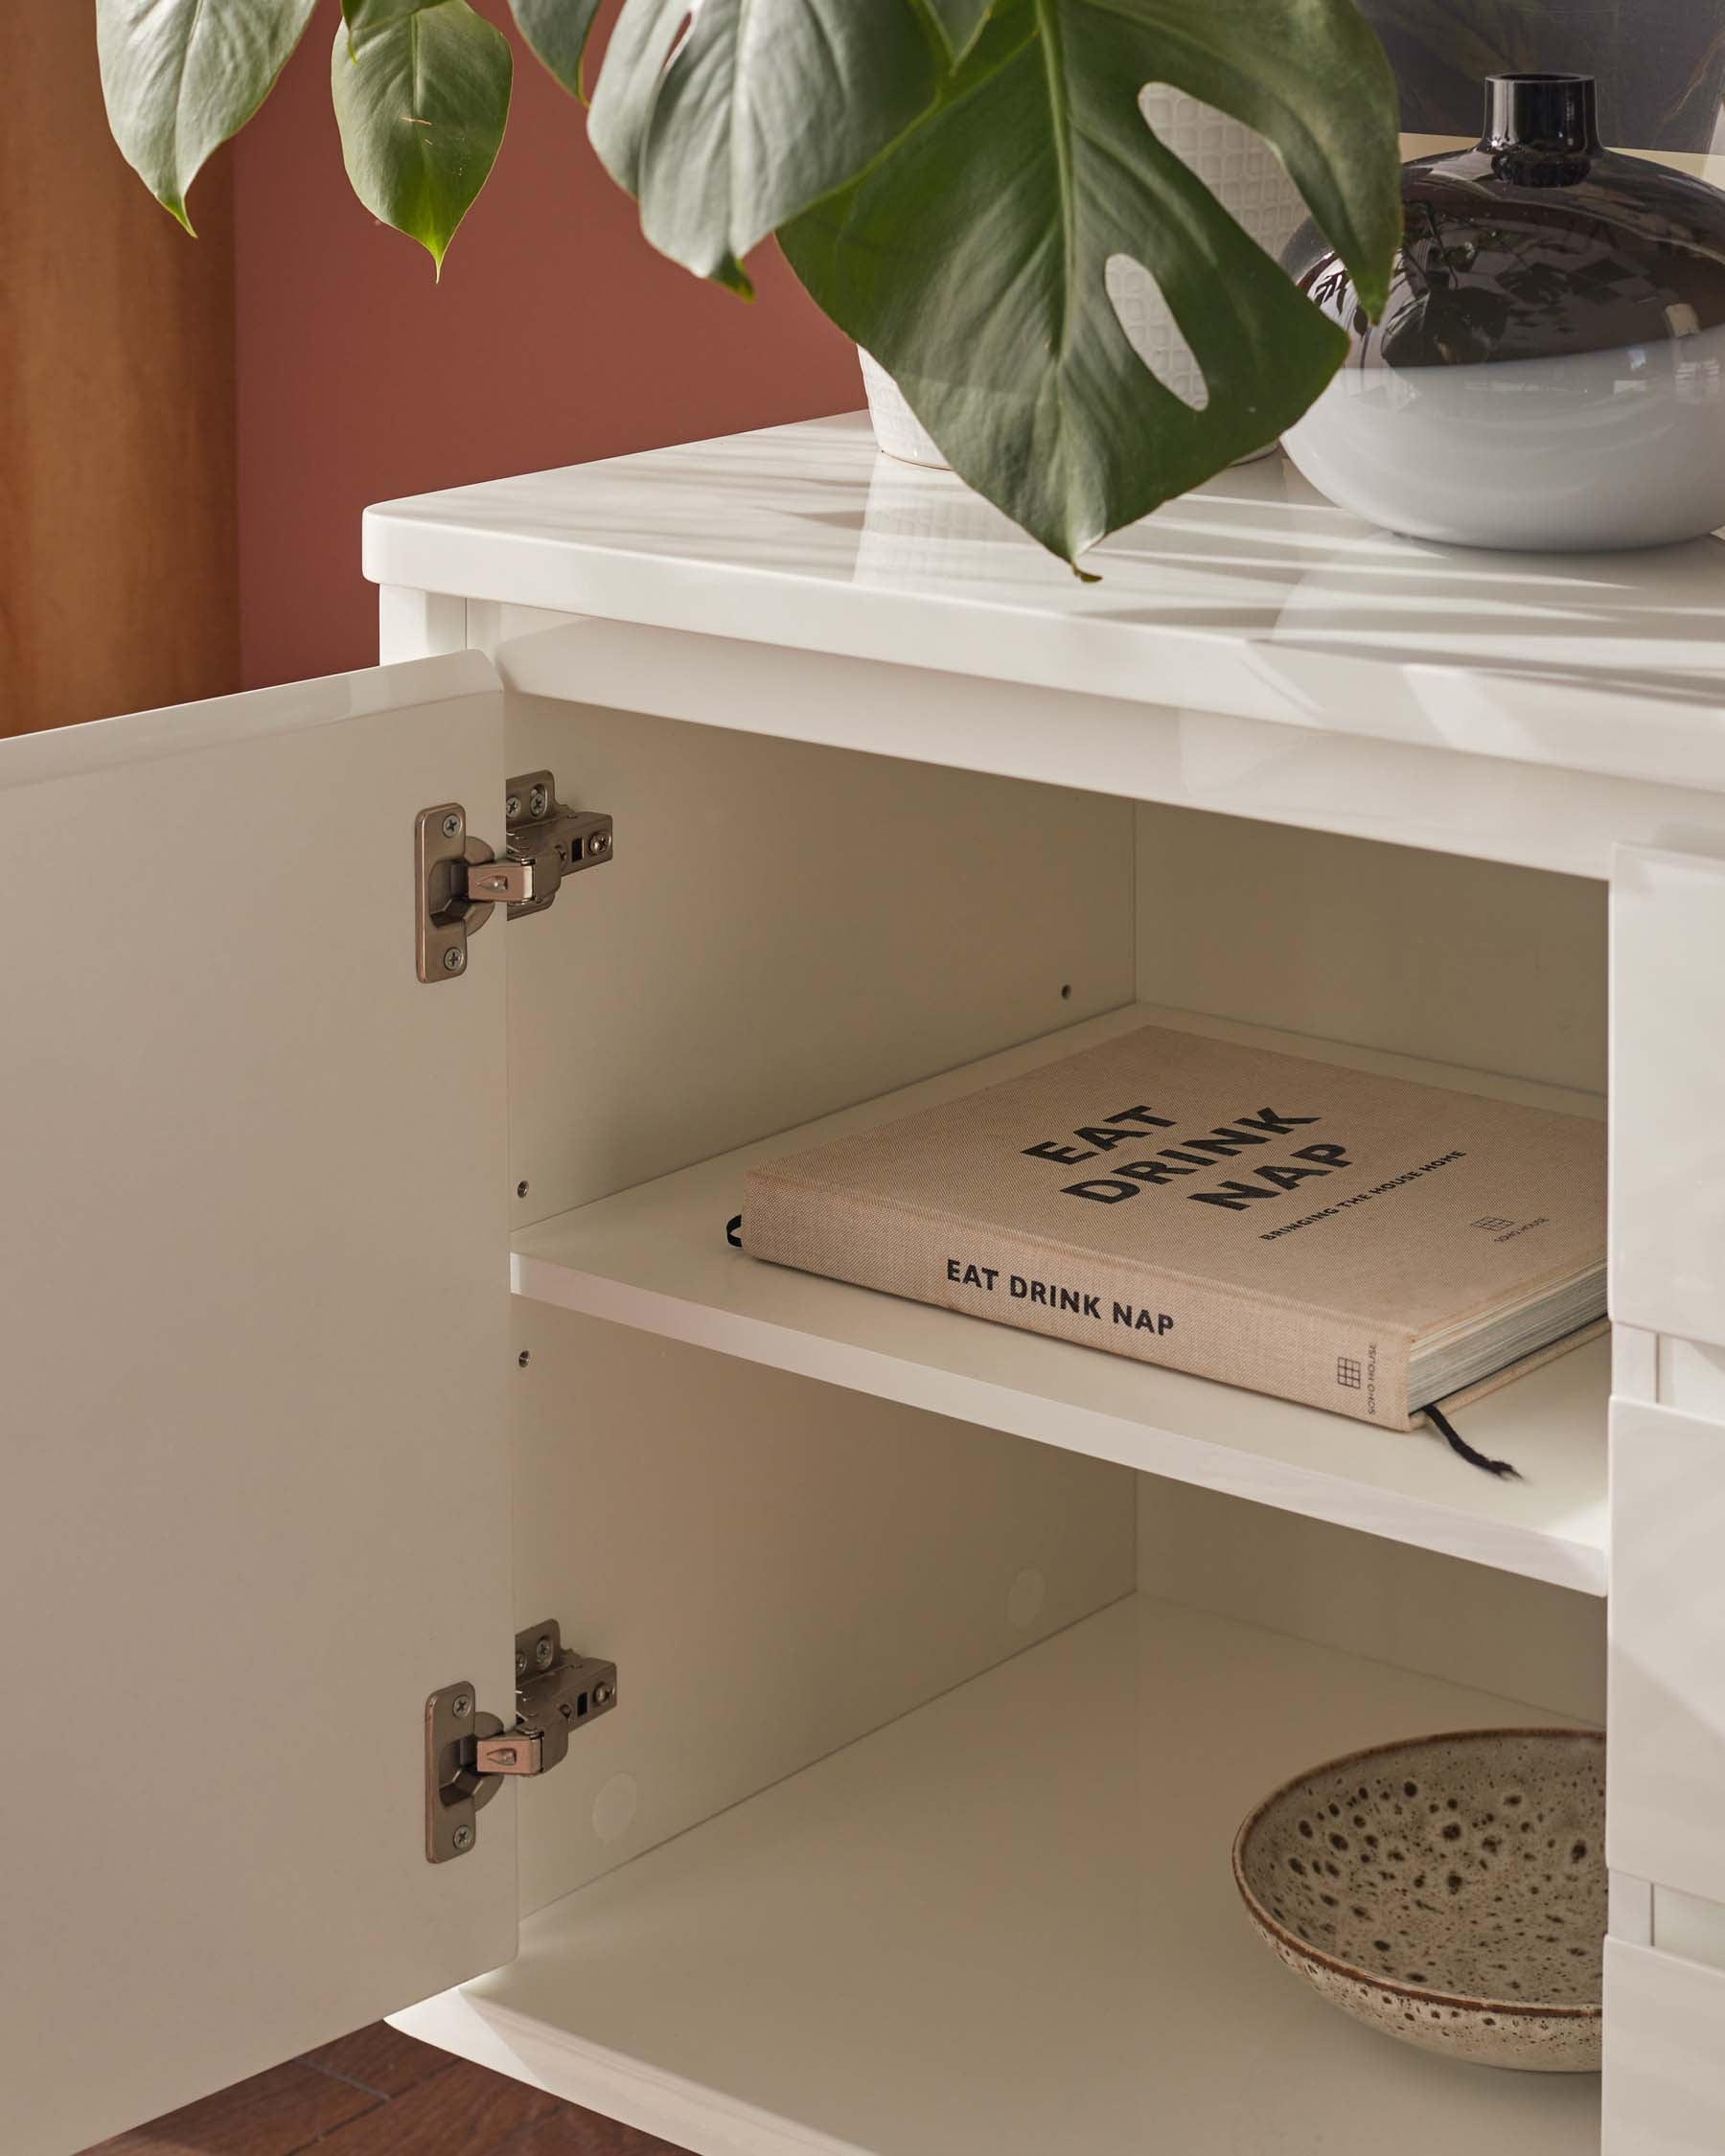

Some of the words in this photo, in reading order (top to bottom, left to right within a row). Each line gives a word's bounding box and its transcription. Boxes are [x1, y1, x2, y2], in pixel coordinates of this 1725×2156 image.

[1020, 1105, 1178, 1165] EAT
[1059, 1107, 1322, 1204] DRINK
[1185, 1143, 1353, 1211] NAP
[1258, 1207, 1340, 1241] BRINGING
[1336, 1193, 1372, 1209] THE
[1368, 1171, 1423, 1195] HOUSE
[1418, 1150, 1467, 1173] HOME
[947, 1258, 999, 1291] EAT
[1009, 1274, 1101, 1319] DRINK
[1113, 1301, 1174, 1336] NAP
[1367, 1384, 1376, 1415] SOHO
